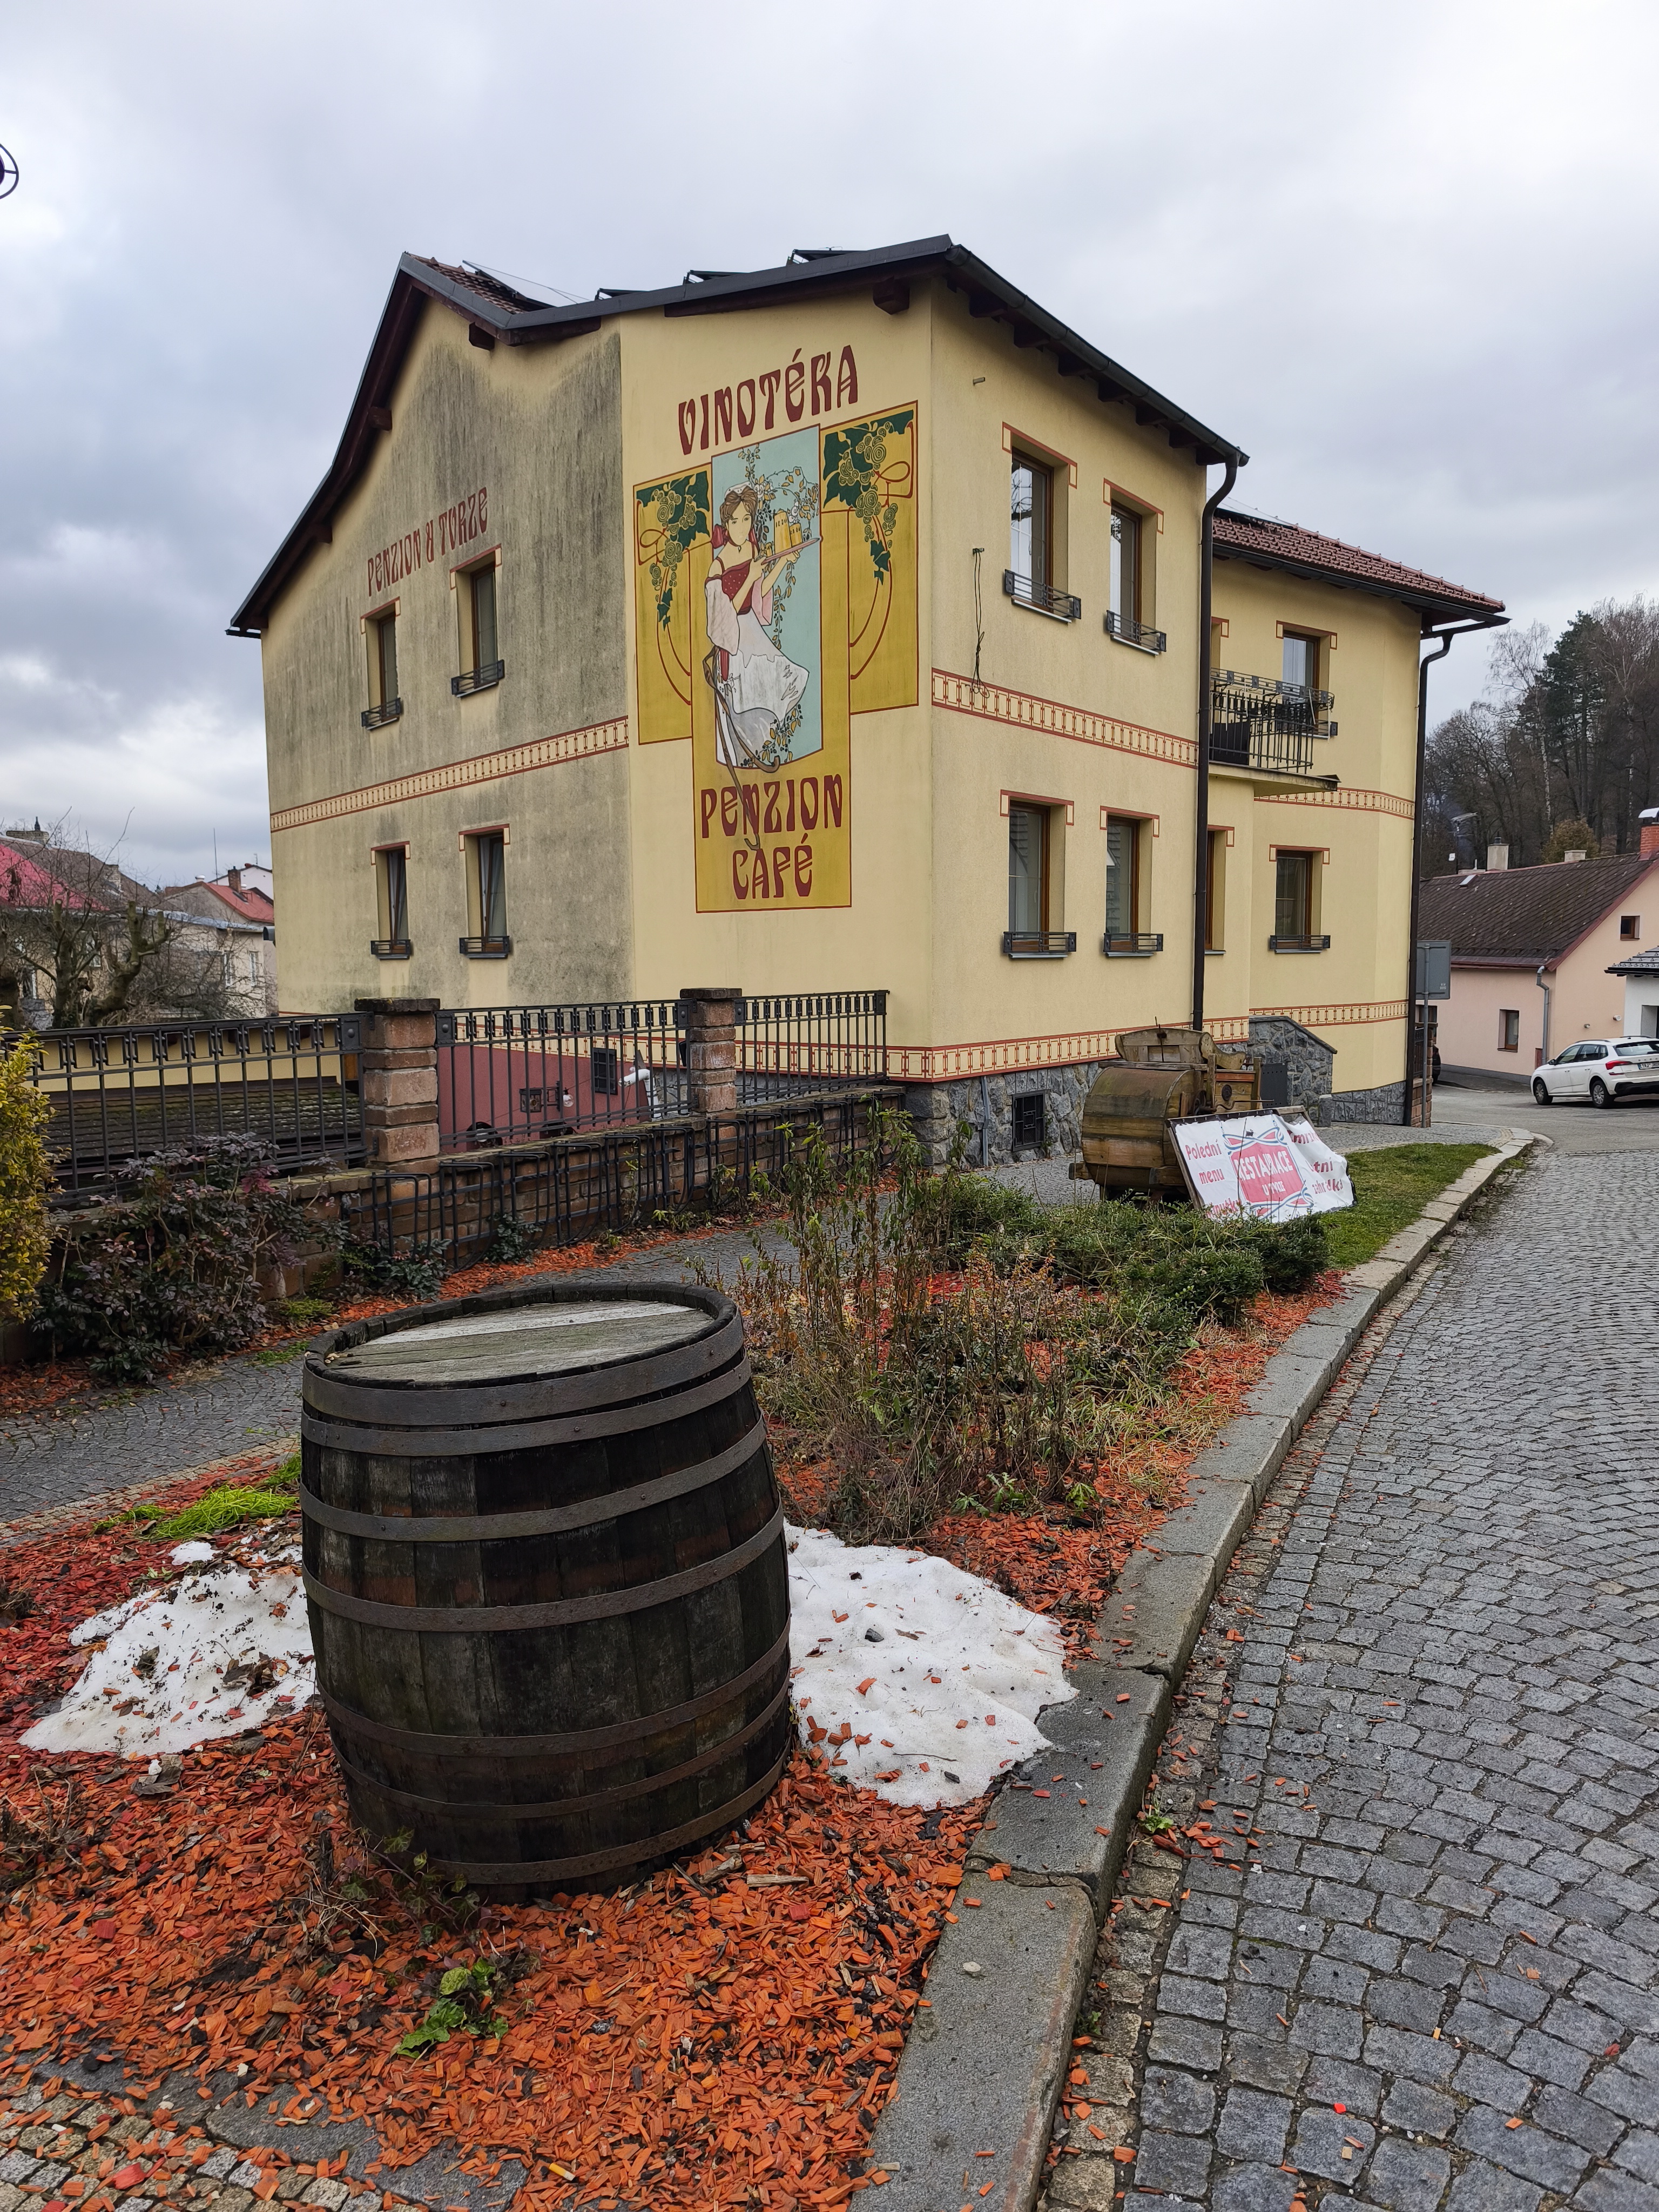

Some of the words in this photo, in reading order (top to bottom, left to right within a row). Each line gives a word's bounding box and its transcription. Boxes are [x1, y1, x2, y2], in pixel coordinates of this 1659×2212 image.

[677, 345, 859, 457] VINOTÉKA
[367, 528, 421, 597] PENZION
[438, 487, 488, 556] TVRZE
[700, 772, 842, 840] PENZION
[732, 832, 813, 900] CAFÉ
[1185, 1139, 1222, 1161] Polední
[1198, 1168, 1225, 1184] menu
[1262, 1184, 1270, 1196] U
